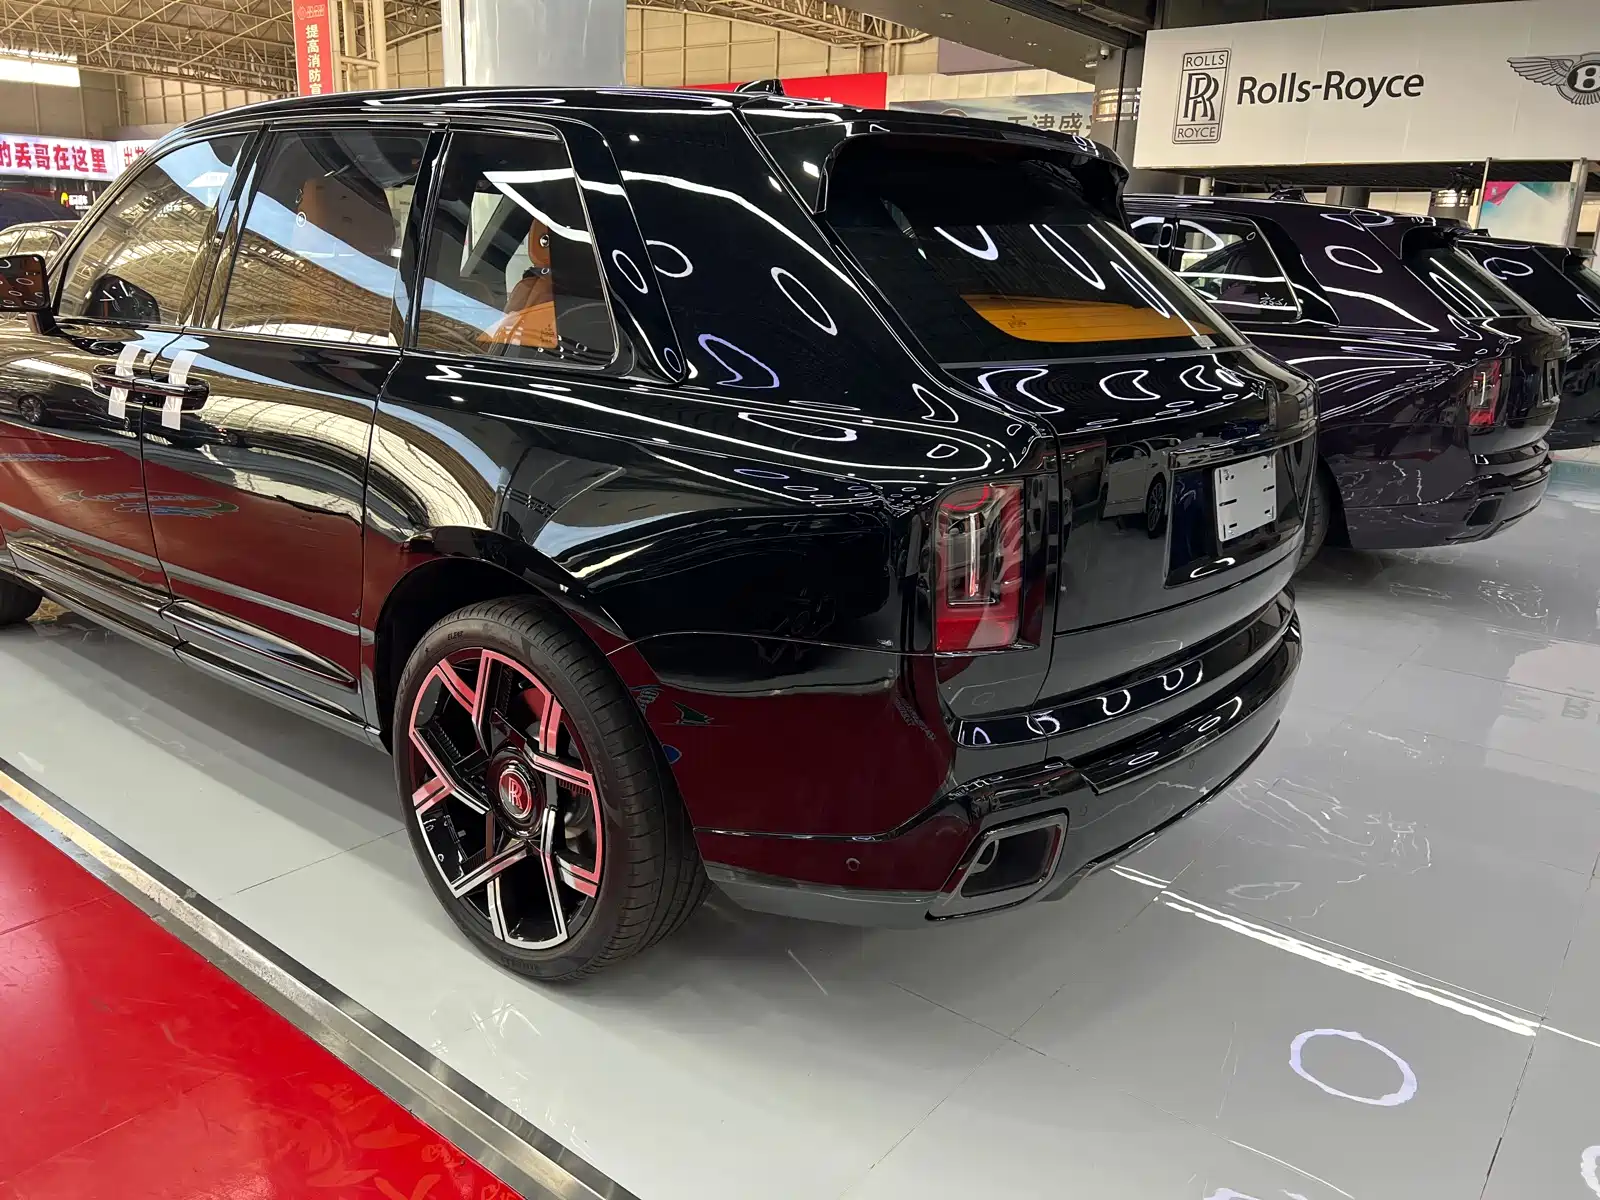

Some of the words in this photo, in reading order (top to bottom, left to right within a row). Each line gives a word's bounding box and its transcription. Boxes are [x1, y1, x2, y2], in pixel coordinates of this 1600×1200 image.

[1185, 54, 1225, 67] ROLLS
[1183, 72, 1220, 122] RR
[1237, 70, 1424, 108] Rolls-Royce
[1177, 126, 1216, 138] ROYCE
